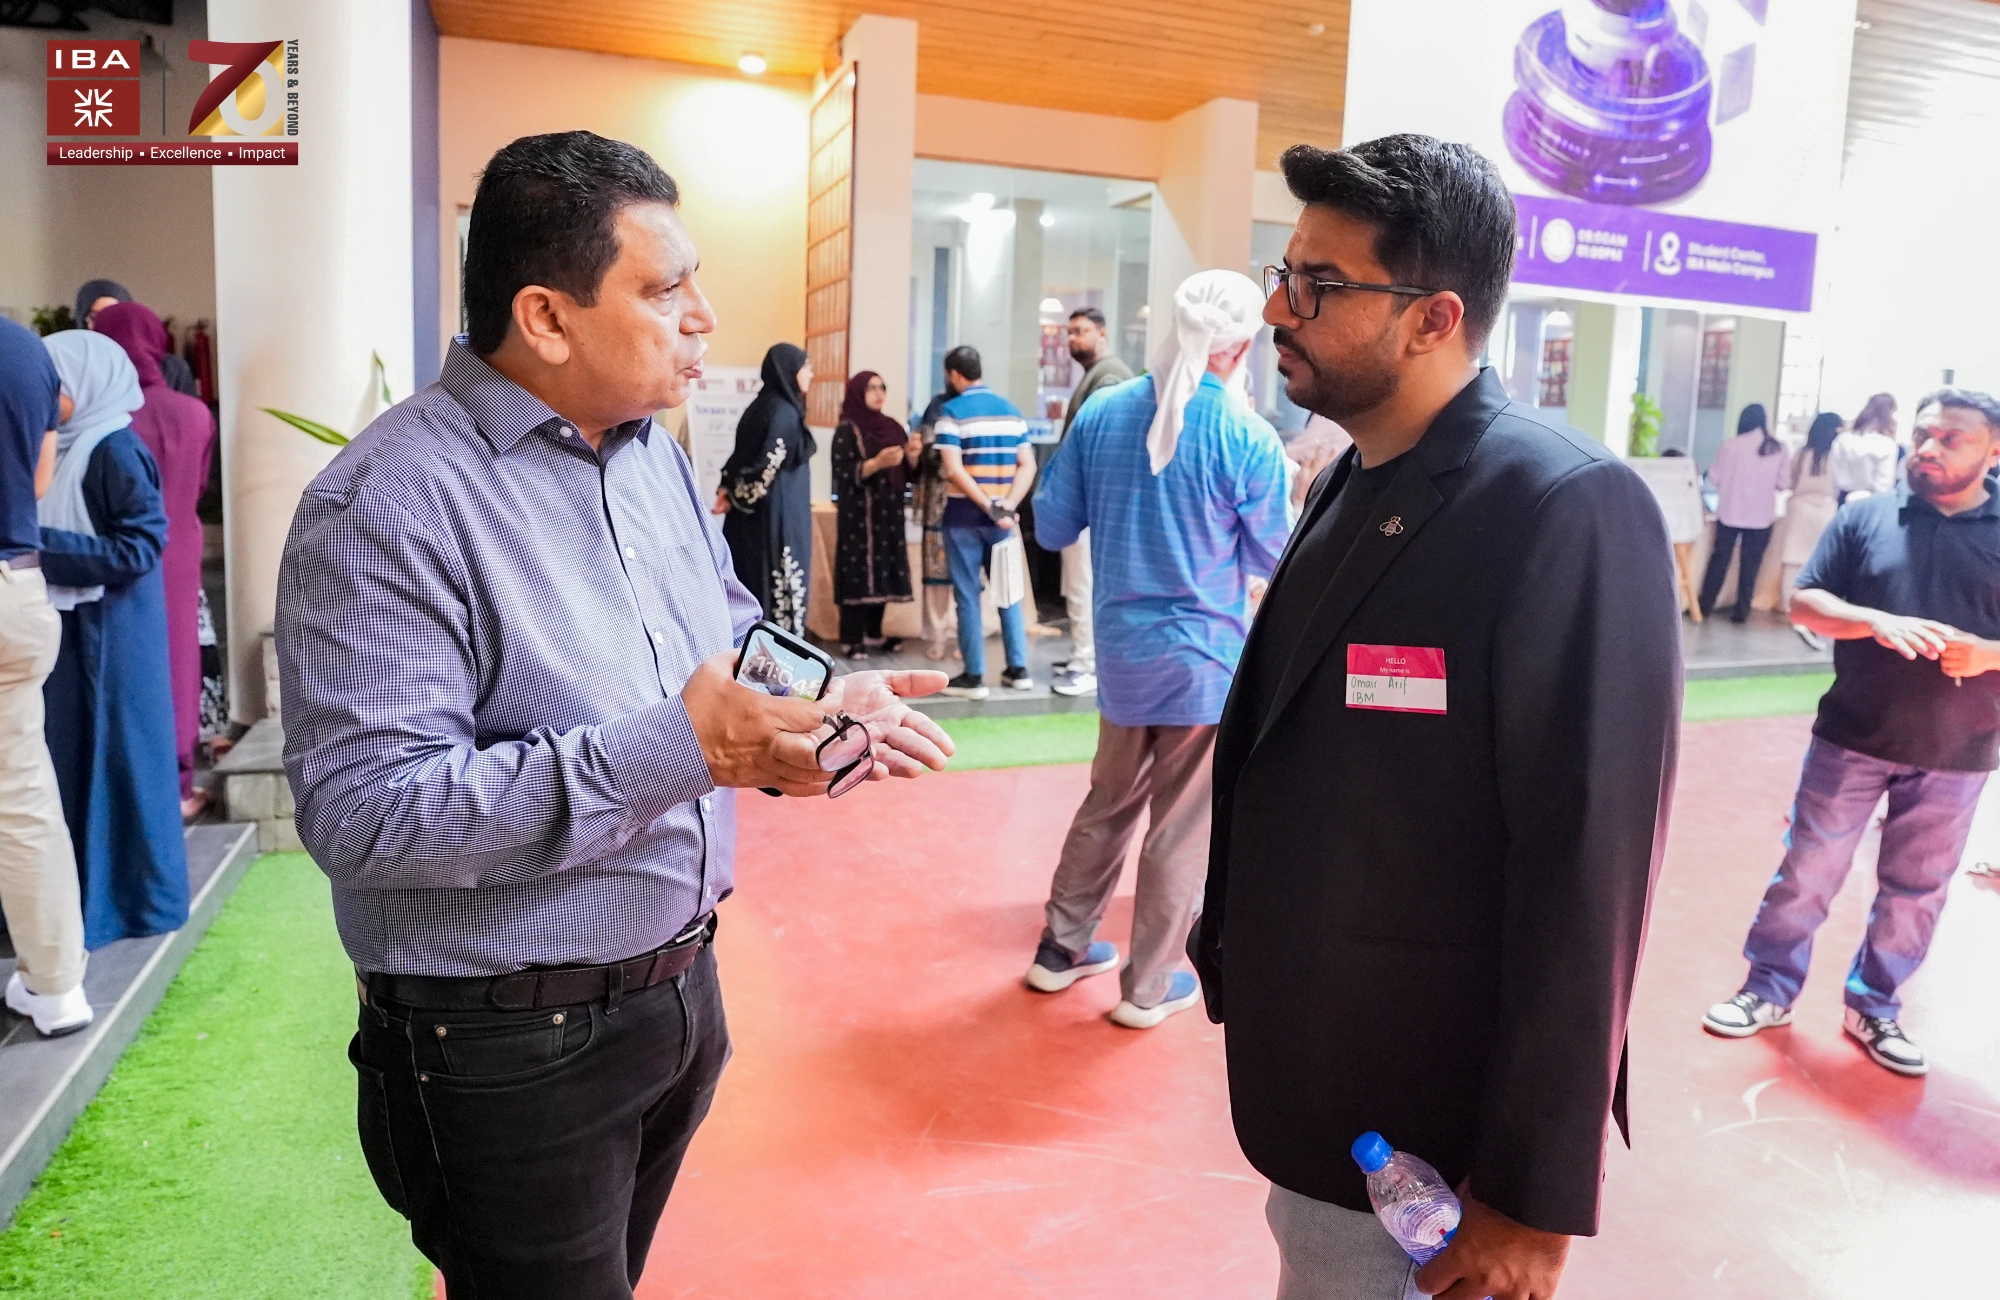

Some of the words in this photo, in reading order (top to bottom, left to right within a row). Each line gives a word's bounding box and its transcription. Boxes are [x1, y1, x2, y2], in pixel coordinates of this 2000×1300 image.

[1385, 657, 1406, 665] HELLO
[1388, 676, 1408, 695] Arif
[1352, 691, 1374, 704] IBM
